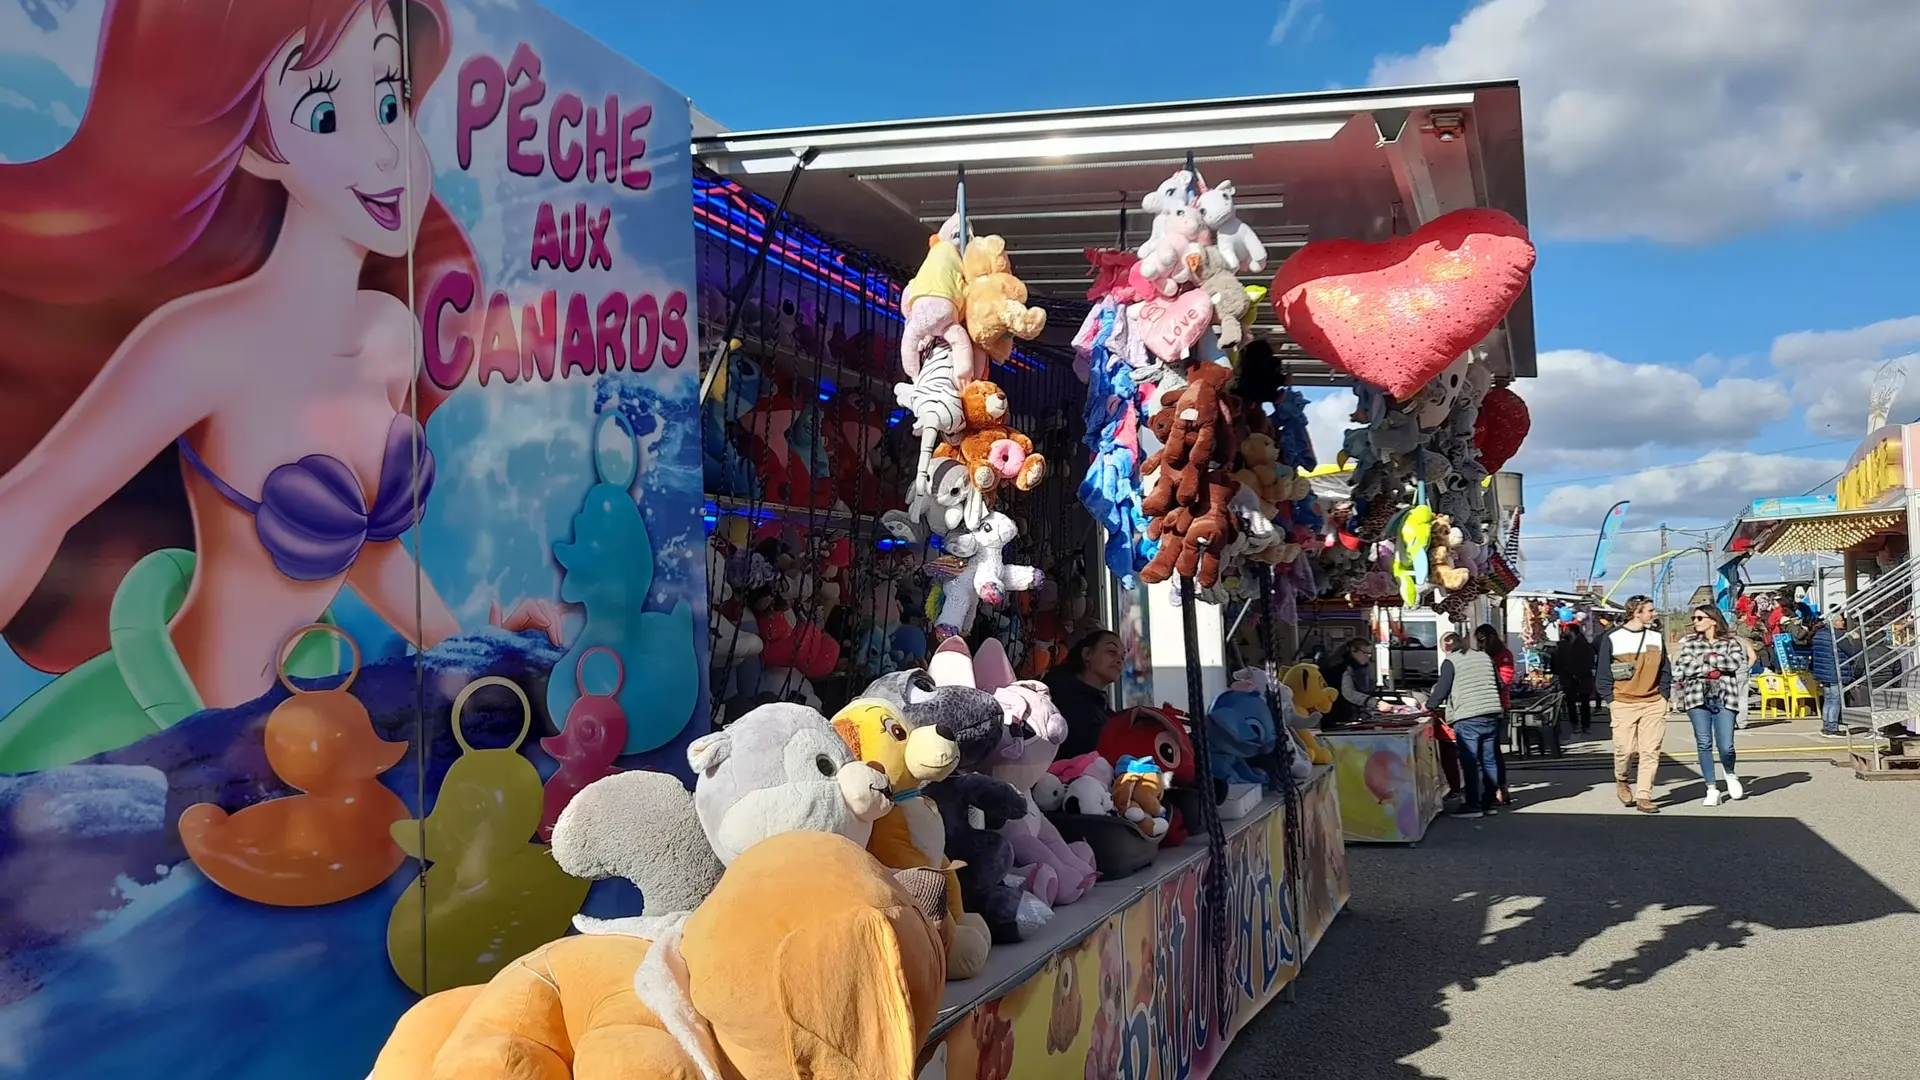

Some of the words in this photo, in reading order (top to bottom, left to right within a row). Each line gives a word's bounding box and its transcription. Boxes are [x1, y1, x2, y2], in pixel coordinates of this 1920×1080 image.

[456, 42, 653, 190] PÊCHE
[530, 201, 612, 272] AUX
[423, 270, 689, 391] CANARDS
[1162, 308, 1199, 346] Love
